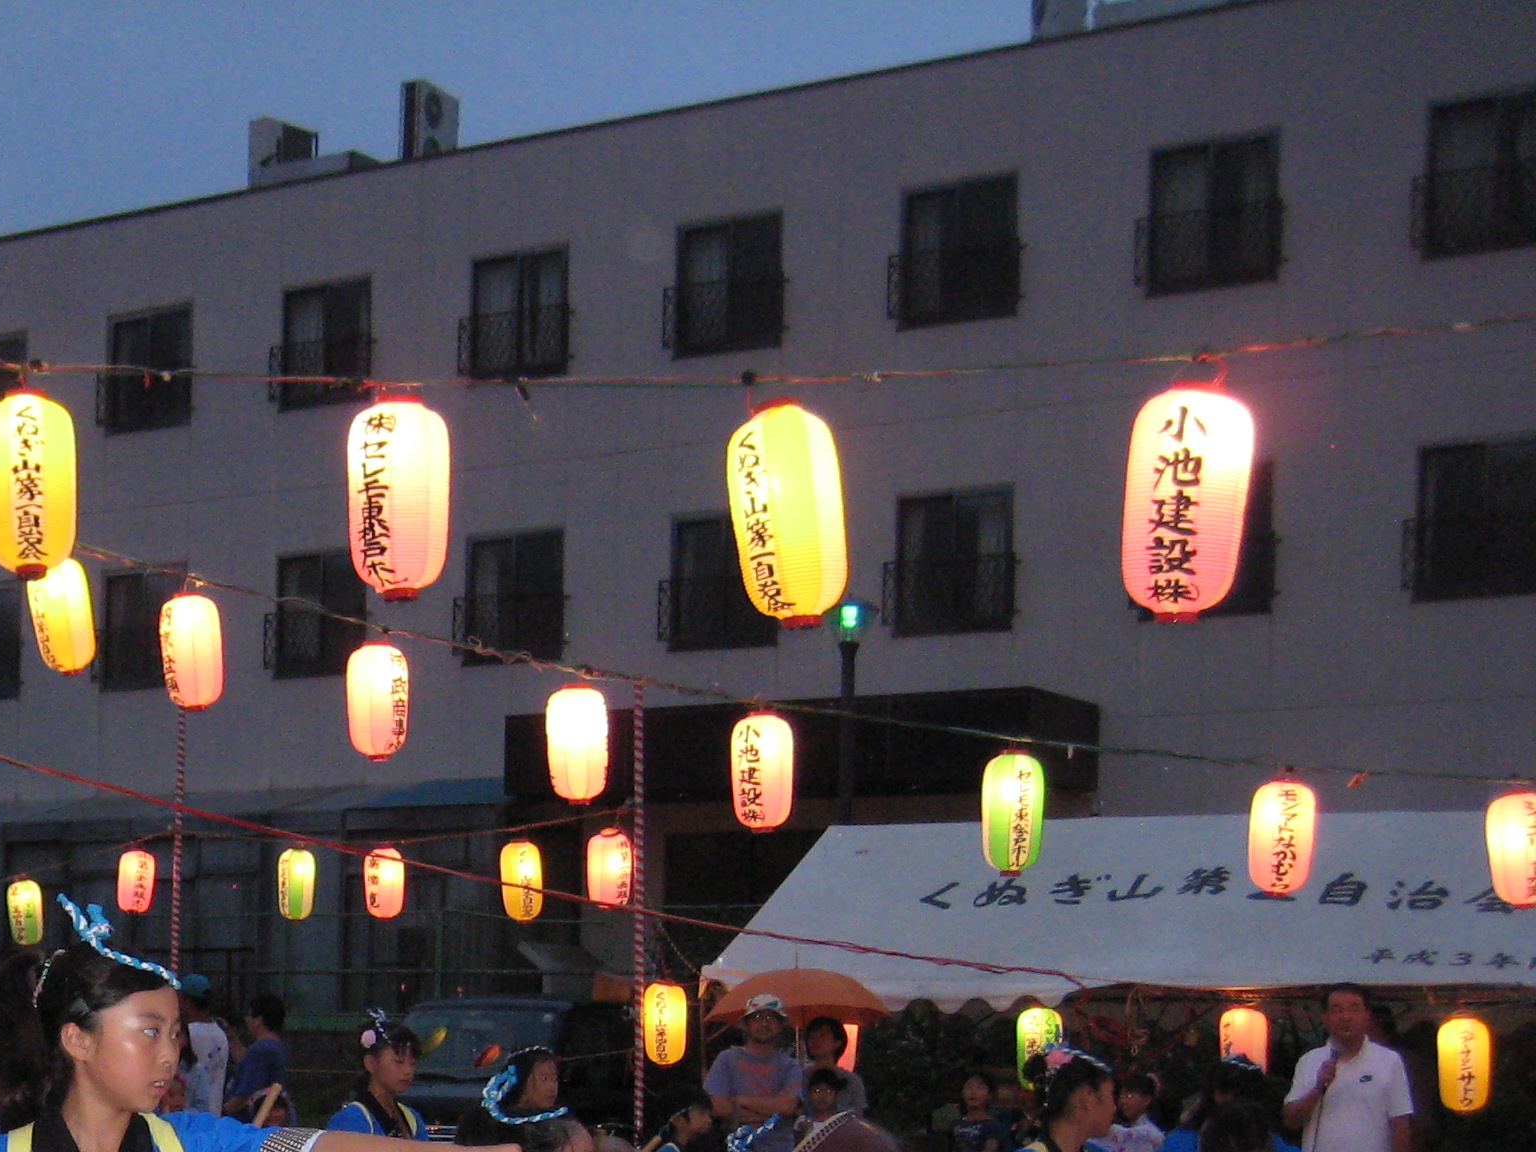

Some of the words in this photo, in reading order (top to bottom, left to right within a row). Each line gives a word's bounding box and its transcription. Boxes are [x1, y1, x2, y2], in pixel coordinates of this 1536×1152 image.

[12, 406, 48, 561] くぬぎ山第一自治会
[737, 431, 796, 613] くぬぎ山第一自治会
[1010, 769, 1033, 868] セレモ東松戸ホール
